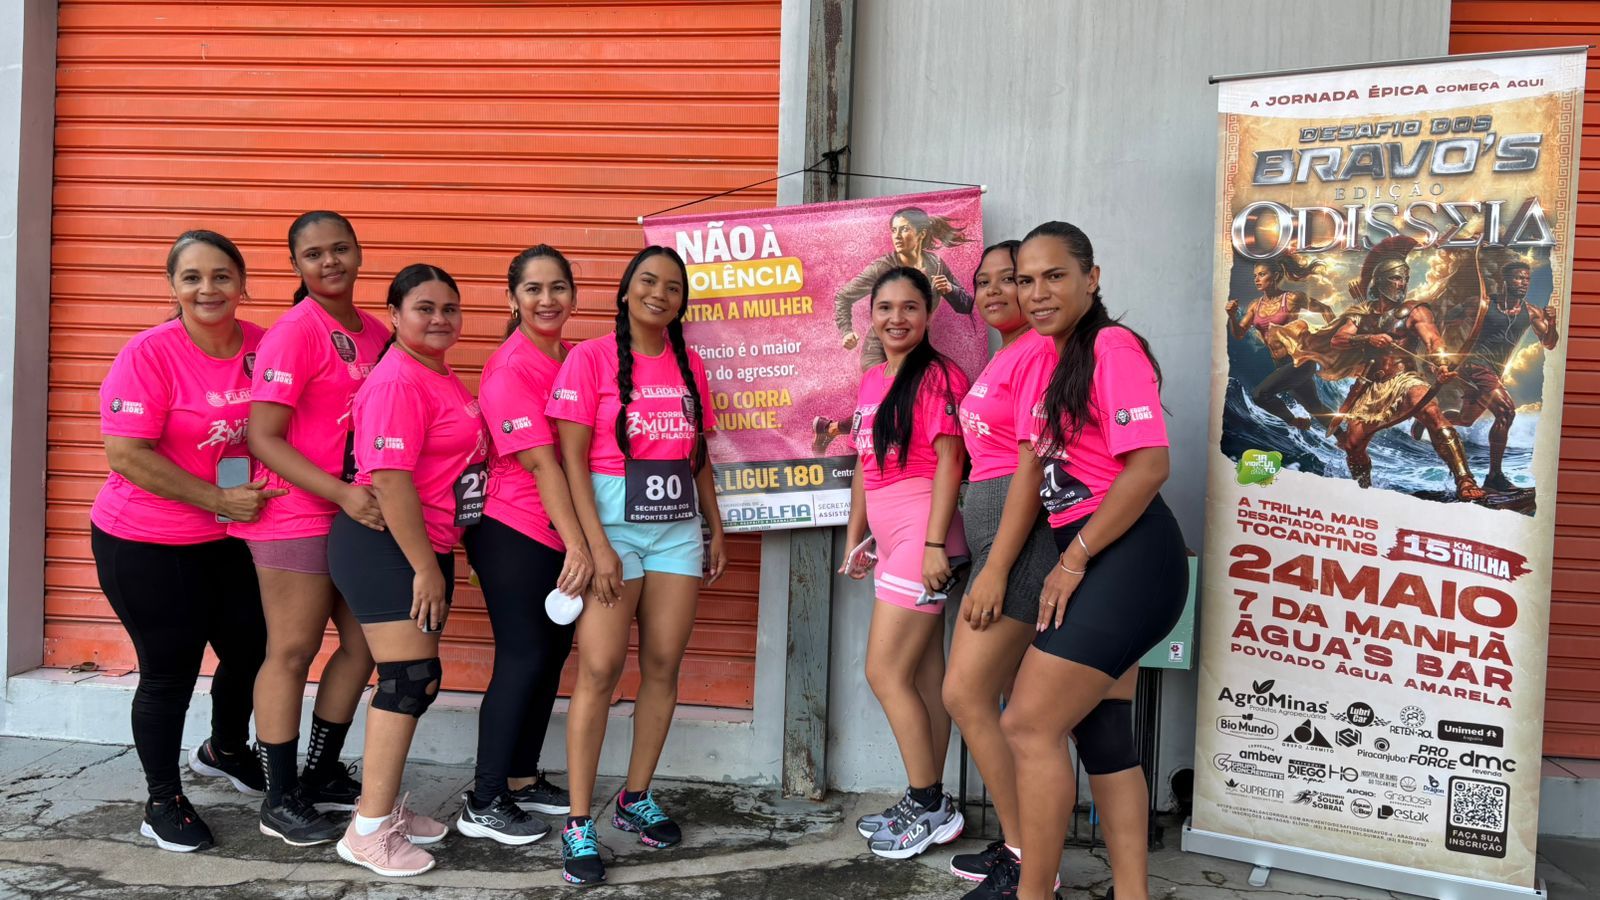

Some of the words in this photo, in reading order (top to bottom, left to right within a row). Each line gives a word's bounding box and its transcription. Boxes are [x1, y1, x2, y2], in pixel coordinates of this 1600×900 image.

[1250, 100, 1259, 108] A
[1265, 89, 1359, 107] JORNADA
[1368, 84, 1429, 98] ÉPICA
[1435, 81, 1500, 93] COMEÇA
[1507, 78, 1544, 88] AQUI
[1299, 119, 1422, 143] DESAFIO
[1430, 114, 1493, 136] DOS
[1251, 131, 1544, 185] BRAVO'S
[1335, 179, 1445, 201] EDIÇÃO
[675, 220, 756, 265] NÃO
[761, 223, 783, 258] À
[688, 264, 801, 291] OLÊNCIA
[681, 303, 724, 322] NTRA
[728, 301, 740, 320] A
[743, 296, 813, 318] MULHER
[690, 343, 734, 359] lêncio
[738, 342, 746, 357] é
[750, 345, 758, 356] o
[763, 339, 801, 355] maior
[716, 365, 733, 380] do
[737, 364, 798, 383] agressor.
[733, 388, 792, 409] CORRA
[122, 406, 144, 415] LIONS
[1131, 410, 1153, 421] LIONS
[717, 411, 784, 430] NUNCIE.
[645, 474, 682, 500] 80
[725, 466, 779, 491] LIGUE
[784, 464, 824, 488] 180
[634, 504, 677, 512] SECRETARIA
[674, 511, 693, 519] LAZER
[727, 502, 811, 521] ADÉLFIA
[1238, 496, 1251, 508] A
[1258, 499, 1324, 521] TRILHA
[1331, 512, 1379, 530] MAIS
[1237, 509, 1347, 537] DESAFIADORA
[1352, 529, 1377, 541] DO
[1237, 519, 1378, 557] TOCANTINS
[1453, 541, 1472, 552] KM
[1403, 534, 1452, 562] 15
[1452, 548, 1511, 579] TRILHA
[1233, 588, 1258, 611] 7
[1272, 595, 1329, 628] DA
[1345, 610, 1513, 667] MANHÃ
[1231, 613, 1393, 667] ÁGUA'S
[1416, 652, 1512, 692] BAR
[1231, 643, 1325, 670] POVOADO
[1335, 661, 1393, 684] ÁGUA
[1404, 678, 1512, 708] AMARELA
[1249, 705, 1276, 714] Produtos
[1279, 709, 1326, 720] Agropecuários
[1353, 715, 1368, 723] Car
[1220, 719, 1237, 730] Bio
[1239, 720, 1274, 735] Mundo
[1444, 724, 1484, 736] Unimed
[1239, 750, 1283, 764] ambev
[1357, 749, 1406, 763] Piracanjuba
[1418, 744, 1449, 757] PRO
[1288, 764, 1326, 778] DIEGO
[1408, 754, 1458, 770] FORCE
[1459, 750, 1517, 773] dmc
[1239, 784, 1284, 799] SUPREMA
[1317, 795, 1344, 806] SOUSA
[1346, 788, 1376, 798] APOIO:
[1312, 801, 1343, 812] SOBRAL
[900, 823, 925, 849] FILA
[1449, 838, 1503, 852] INSCRIÇÃO
[1452, 829, 1478, 841] FAÇA
[1480, 833, 1500, 843] SUA
